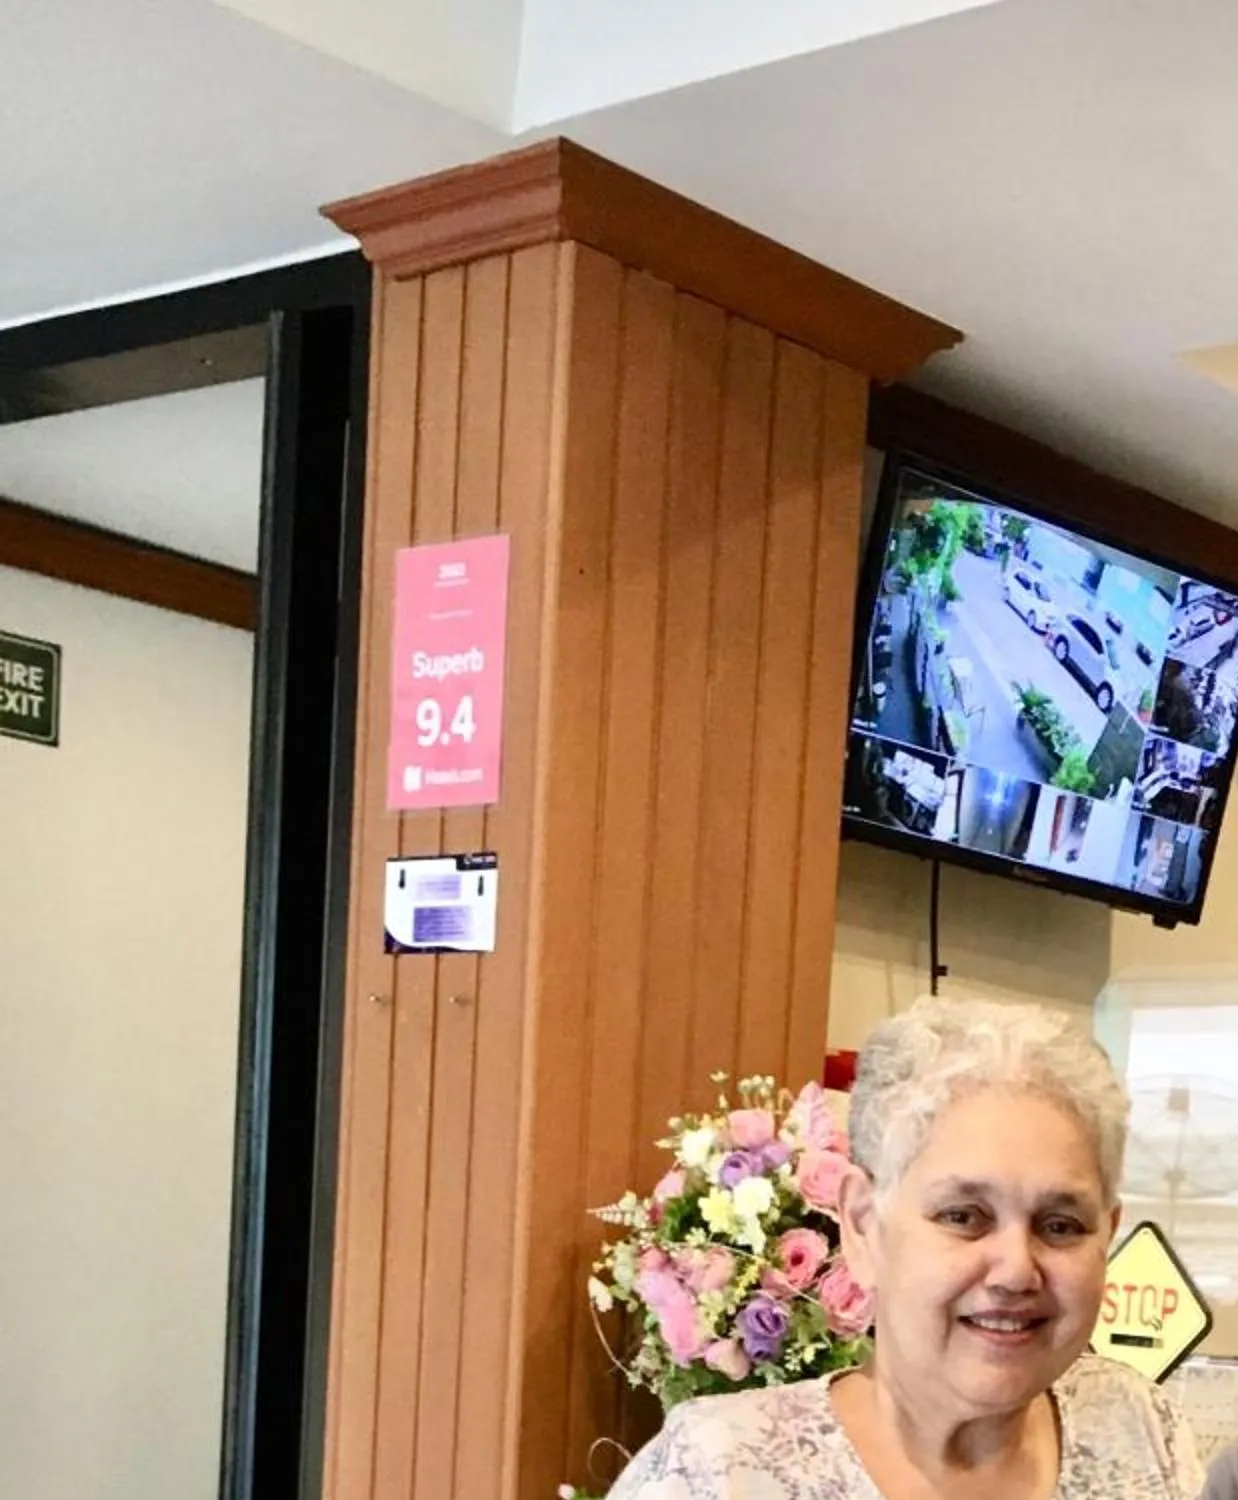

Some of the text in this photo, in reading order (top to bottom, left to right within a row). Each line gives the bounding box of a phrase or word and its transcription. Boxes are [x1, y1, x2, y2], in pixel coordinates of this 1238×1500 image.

[0, 658, 45, 694] IRE
[412, 646, 484, 680] Superb
[416, 695, 477, 746] 9.4
[1101, 1282, 1178, 1326] STOP
